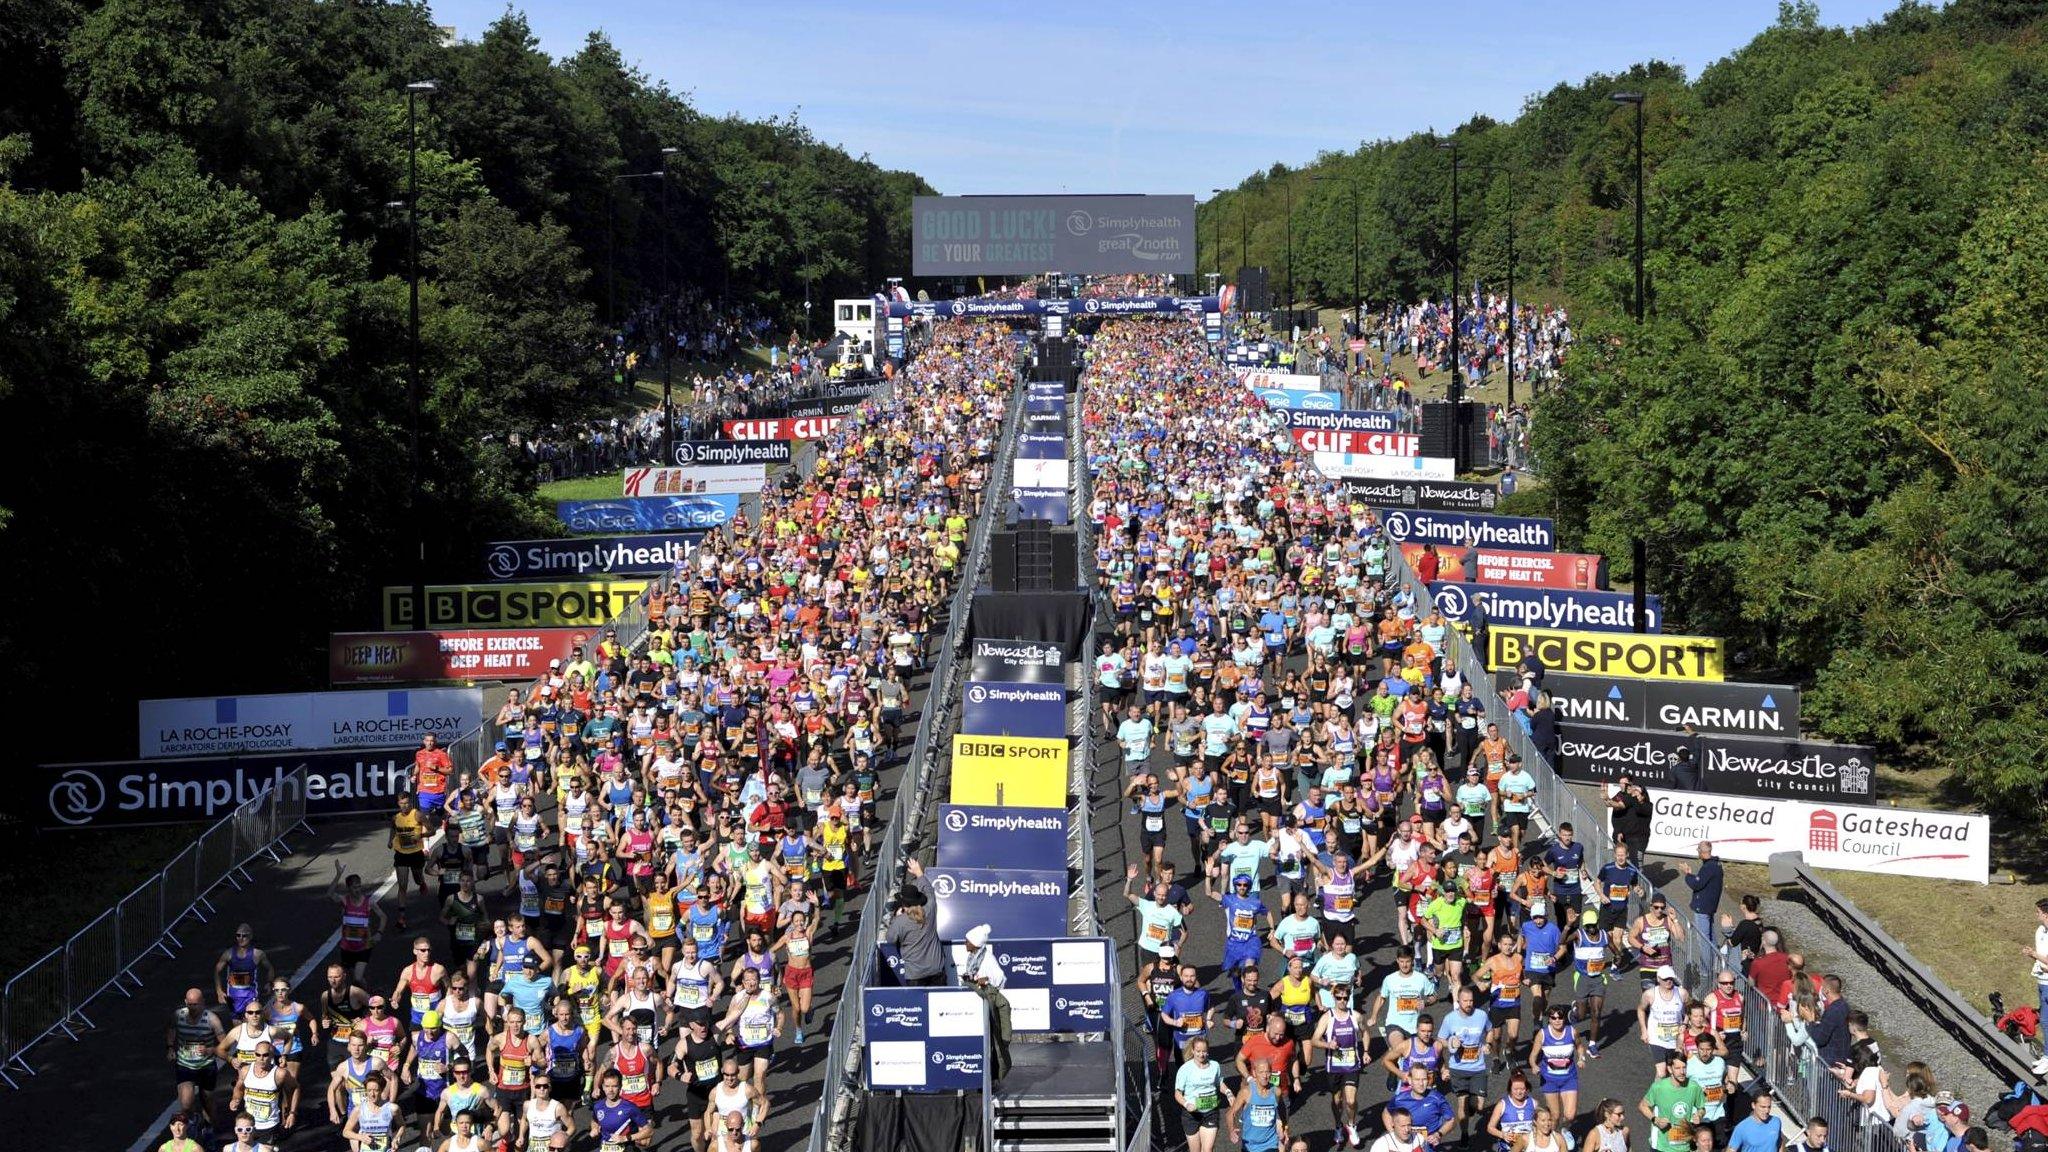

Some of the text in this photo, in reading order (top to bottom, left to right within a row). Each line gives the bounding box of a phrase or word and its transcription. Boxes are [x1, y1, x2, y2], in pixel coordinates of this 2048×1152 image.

[922, 209, 1056, 240] GOOD LUCK!
[1098, 216, 1180, 230] Simplyhealth
[922, 242, 1055, 262] BE YOUR GREATEST
[1098, 238, 1179, 253] great north
[967, 302, 1024, 312] Simplyhealth
[1101, 301, 1157, 310] Simplyhealth
[1293, 411, 1391, 431] Simplyhealth
[732, 420, 779, 440] CLIF
[1029, 435, 1063, 443] Simplyhealth
[1301, 431, 1419, 457] CLIF CLIF
[697, 443, 788, 464] Simplyhealth
[1023, 489, 1065, 498] Simplyhealth
[1420, 485, 1480, 500] Newcastle
[1415, 517, 1549, 547] Simplyhealth
[1477, 554, 1554, 569] BEFORE EXERCISE.
[1484, 568, 1507, 579] DEEP
[1509, 570, 1531, 581] HEAT
[507, 590, 641, 621] SPORT
[440, 637, 543, 651] BEFORE EXERCISE.
[977, 643, 1044, 658] Newcastle
[344, 644, 405, 665] DEEP HEAT
[451, 654, 480, 669] DEEP
[484, 654, 514, 668] HEAT
[1004, 658, 1017, 666] City
[1573, 641, 1717, 677] SPORT
[989, 689, 1061, 702] Simplyhealth
[160, 724, 292, 742] LA ROCHE-POSAY
[334, 717, 462, 734] LA ROCHE-POSAY
[160, 739, 293, 753] LABORATOIRE DERMATOLOGIQUE
[334, 734, 389, 744] LABORATOIRE
[960, 742, 1061, 759] BBC SPORT
[1590, 763, 1614, 776] City
[1707, 748, 1836, 779] Newcastle
[118, 760, 411, 816] Simplyhealth
[1757, 778, 1835, 793] City Council
[1655, 796, 1775, 826] Gateshead
[971, 815, 1062, 831] Simplyhealth
[1654, 820, 1709, 840] Council
[1842, 812, 1969, 842] Gateshead
[1842, 838, 1900, 857] Council
[960, 879, 1060, 898] Simplyhealth
[1069, 1000, 1103, 1008] Simplyhealth
[946, 1053, 982, 1061] Simplyhealth
